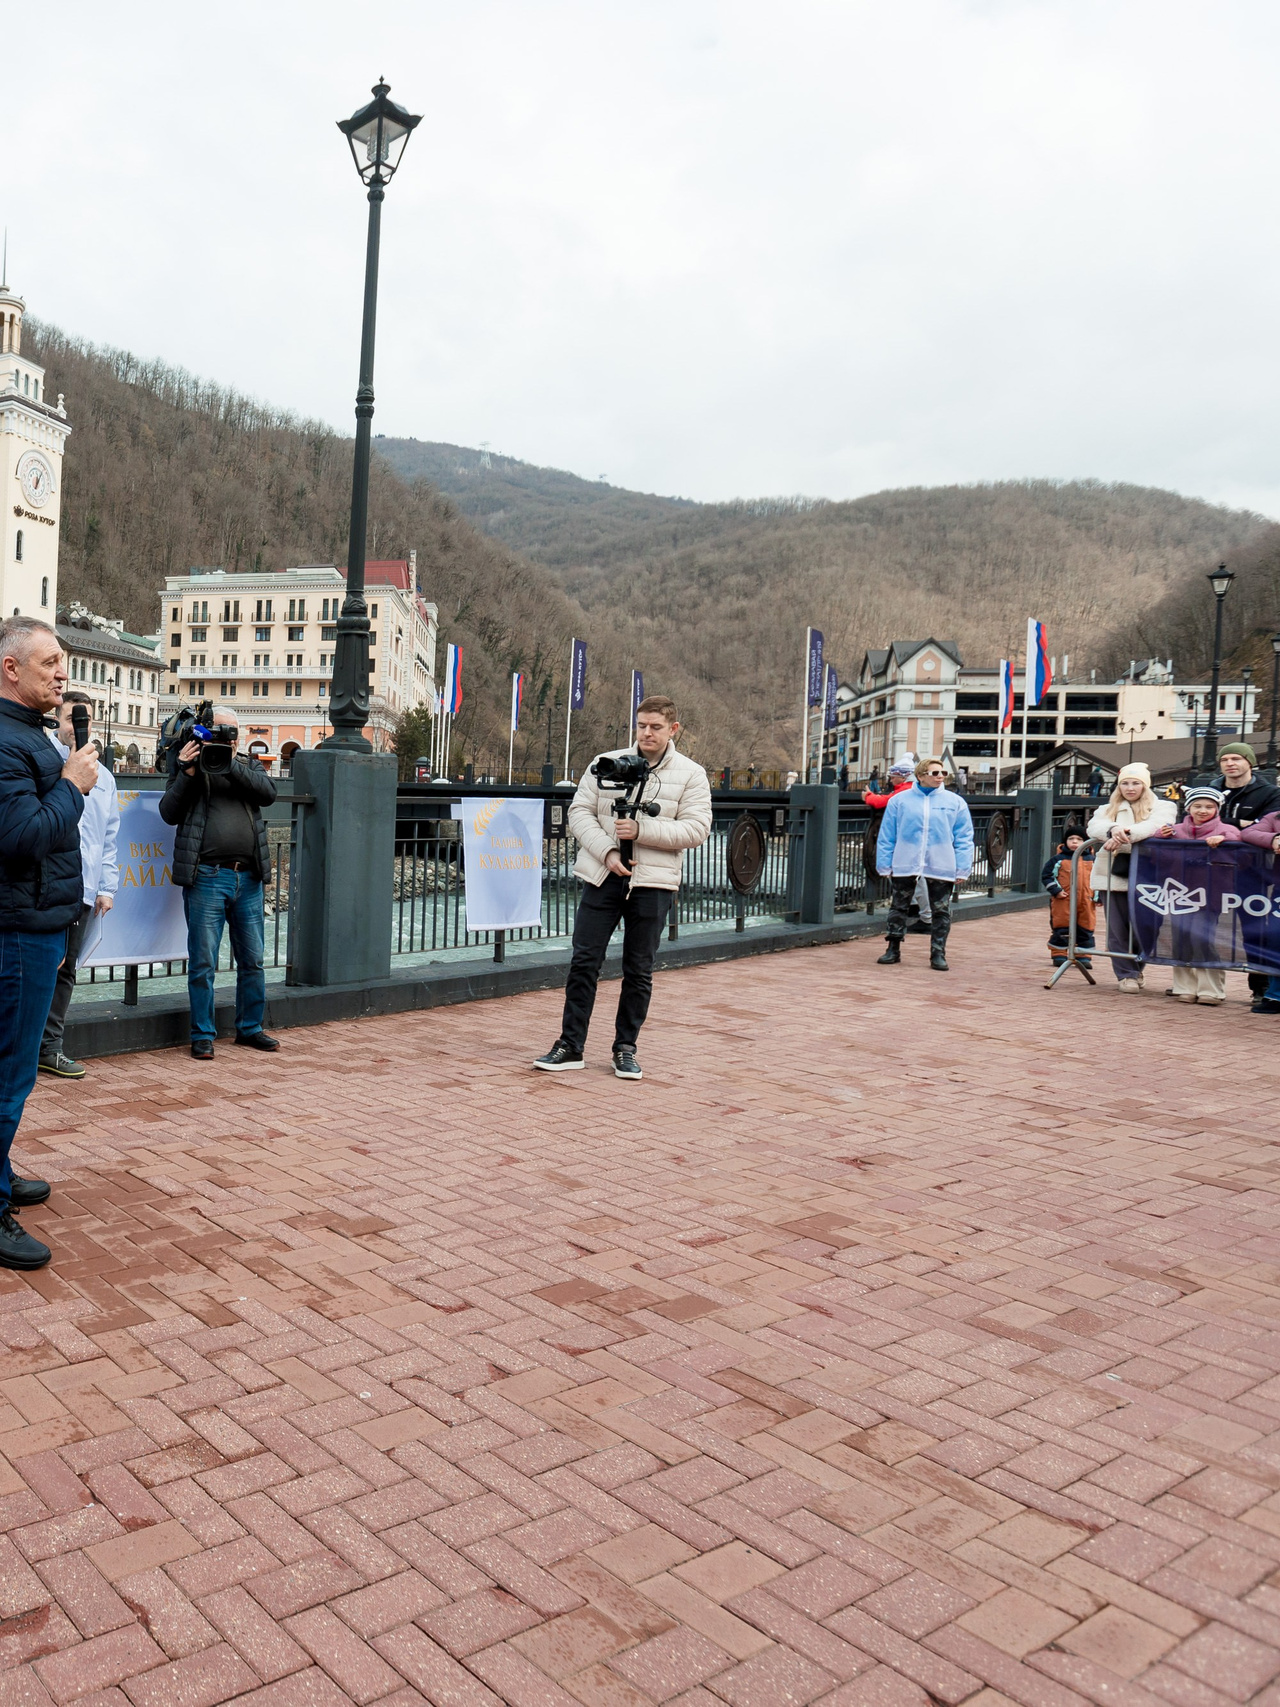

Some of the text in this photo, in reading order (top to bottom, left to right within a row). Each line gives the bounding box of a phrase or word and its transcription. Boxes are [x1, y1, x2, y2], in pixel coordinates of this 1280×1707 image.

[24, 510, 56, 526] РОЗА ХУТОР
[129, 842, 165, 858] ВИК
[491, 836, 523, 849] ГАЛИНА
[479, 853, 539, 869] КУЛАКОВА
[118, 858, 174, 887] АЙЛ
